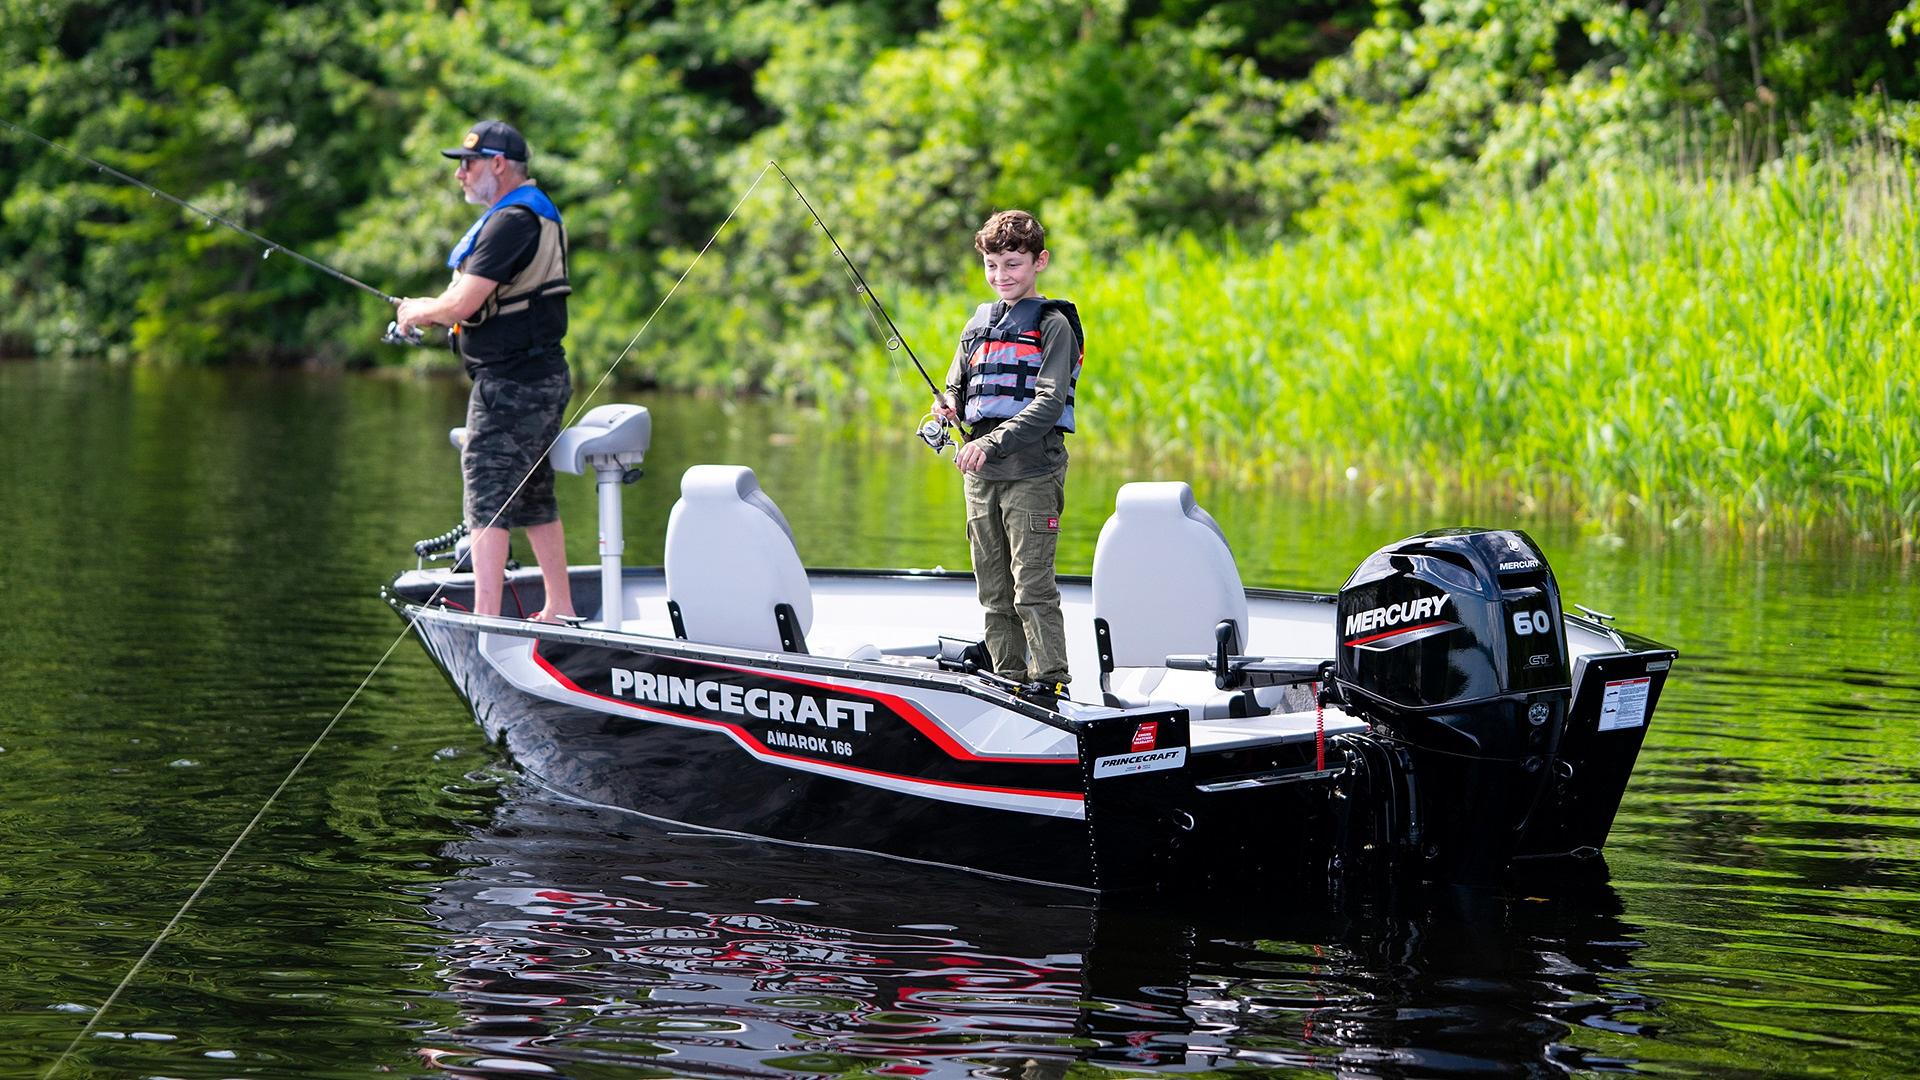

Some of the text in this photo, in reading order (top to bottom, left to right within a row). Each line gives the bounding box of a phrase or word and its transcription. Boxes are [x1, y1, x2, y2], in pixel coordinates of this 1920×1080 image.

[1500, 560, 1539, 570] MERCURY
[1345, 593, 1450, 636] MERCURY
[1513, 610, 1550, 636] 60
[1529, 654, 1549, 665] CT
[611, 667, 874, 732] PRINCECRAFT
[767, 730, 853, 757] AMAROK 166
[1101, 751, 1179, 768] PRINCECRAFT
